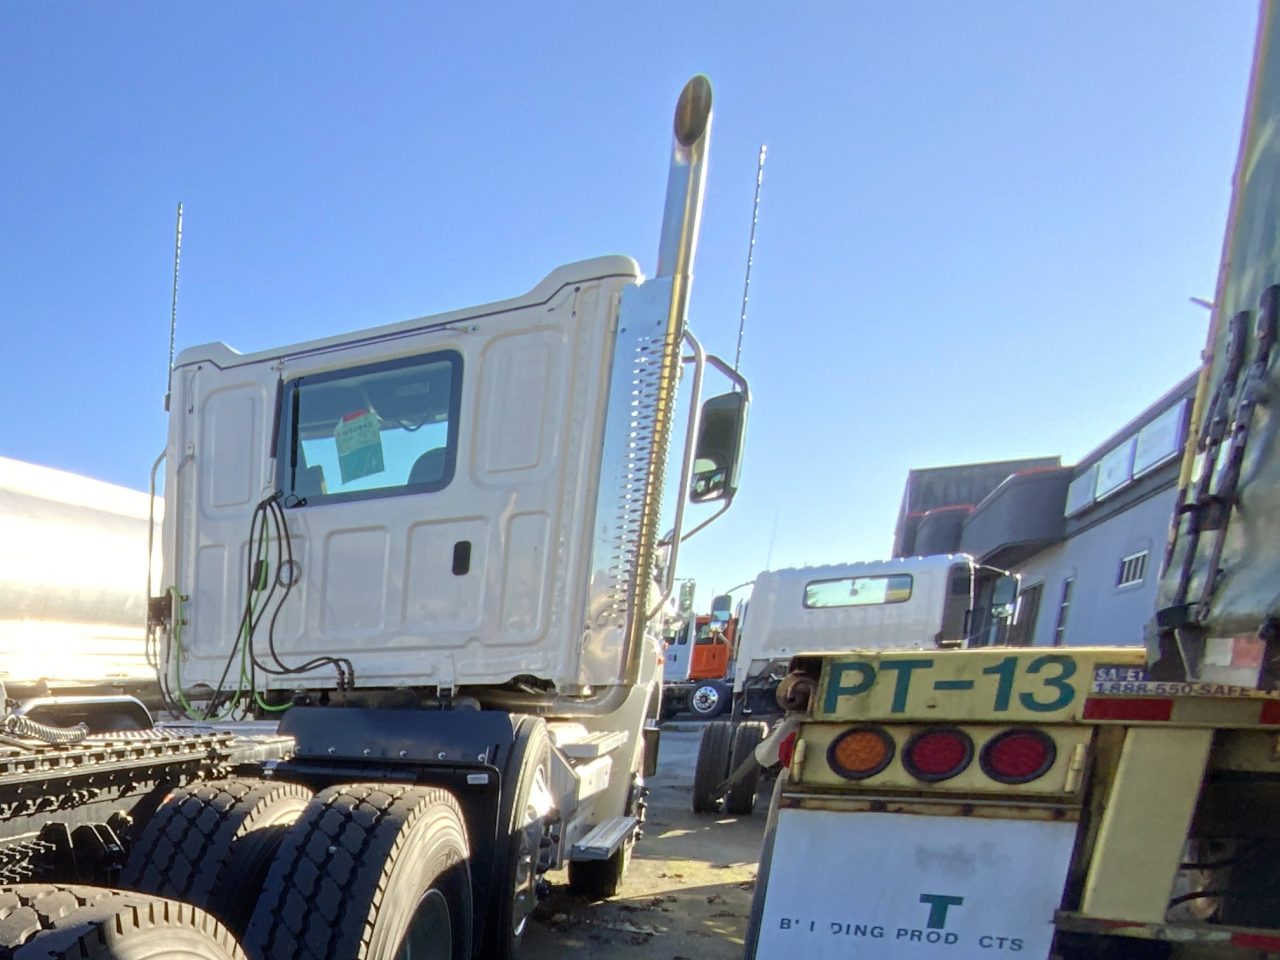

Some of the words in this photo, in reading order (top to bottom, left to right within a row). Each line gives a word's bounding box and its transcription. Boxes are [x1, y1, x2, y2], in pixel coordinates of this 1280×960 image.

[823, 654, 1077, 714] PT-13
[919, 893, 964, 929] T
[896, 928, 1025, 952] PRODCTS
